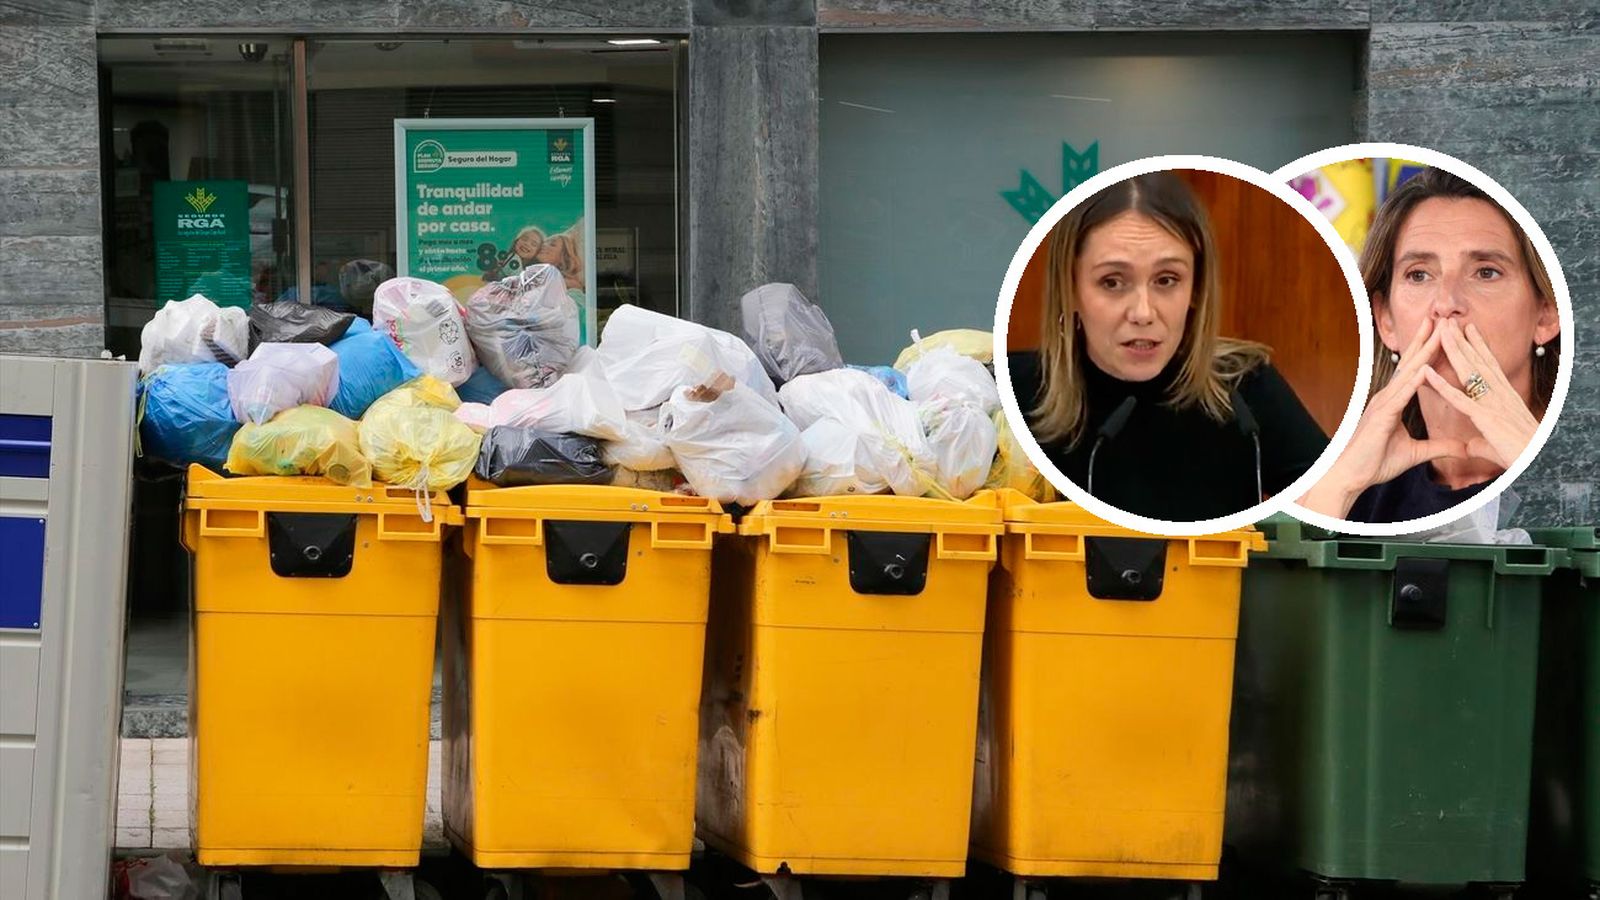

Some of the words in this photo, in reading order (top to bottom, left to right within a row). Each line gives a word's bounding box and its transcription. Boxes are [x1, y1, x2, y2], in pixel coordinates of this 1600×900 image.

[447, 155, 474, 165] Seguro
[475, 155, 488, 163] del
[489, 155, 512, 164] Hogar
[416, 183, 524, 202] Tranquilidad
[417, 201, 439, 216] de
[442, 201, 493, 215] andar
[178, 218, 225, 228] RGA
[417, 221, 447, 236] por
[450, 221, 496, 233] casa.
